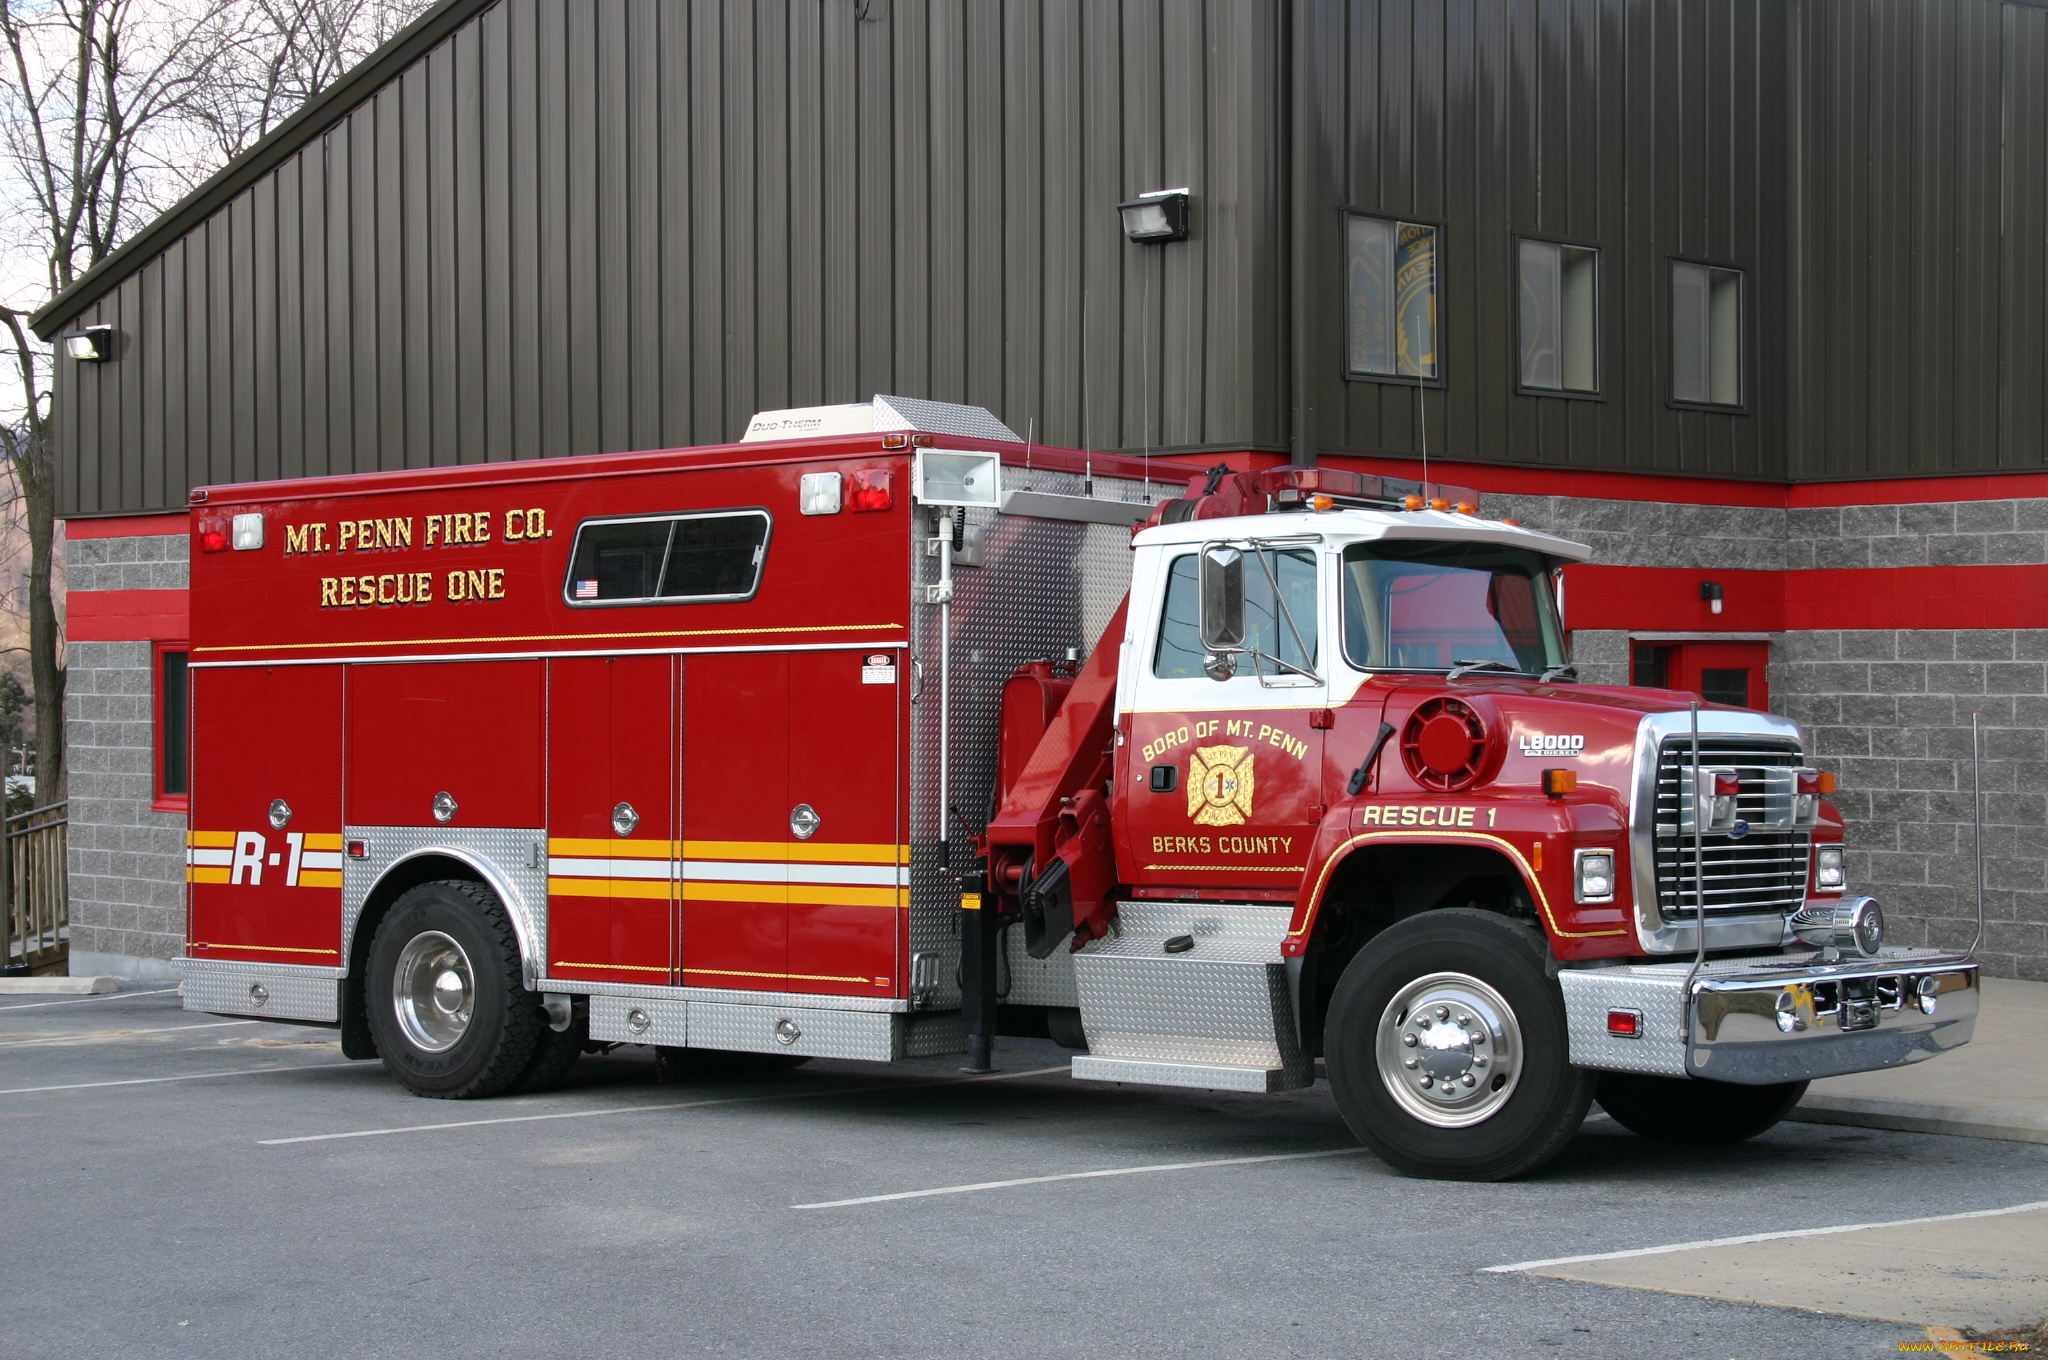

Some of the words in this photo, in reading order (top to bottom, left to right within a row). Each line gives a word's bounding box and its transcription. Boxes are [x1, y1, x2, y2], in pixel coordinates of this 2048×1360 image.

[285, 523, 331, 553] MT.
[339, 517, 413, 550] PENN
[425, 511, 491, 546] FIRE
[504, 508, 553, 540] CO.
[320, 572, 433, 607] RESCUE
[447, 569, 506, 601] ONE
[1141, 726, 1189, 762] BORO
[1195, 719, 1220, 739] OF
[1226, 719, 1254, 738] MT.
[1258, 724, 1308, 760] PENN
[1519, 735, 1584, 750] L8000
[1215, 772, 1225, 799] 1
[1362, 805, 1476, 827] RESCUE
[1487, 807, 1497, 827] 1
[231, 831, 304, 887] R-1
[1152, 836, 1211, 853] BERKS
[1218, 836, 1293, 854] COUNTY
